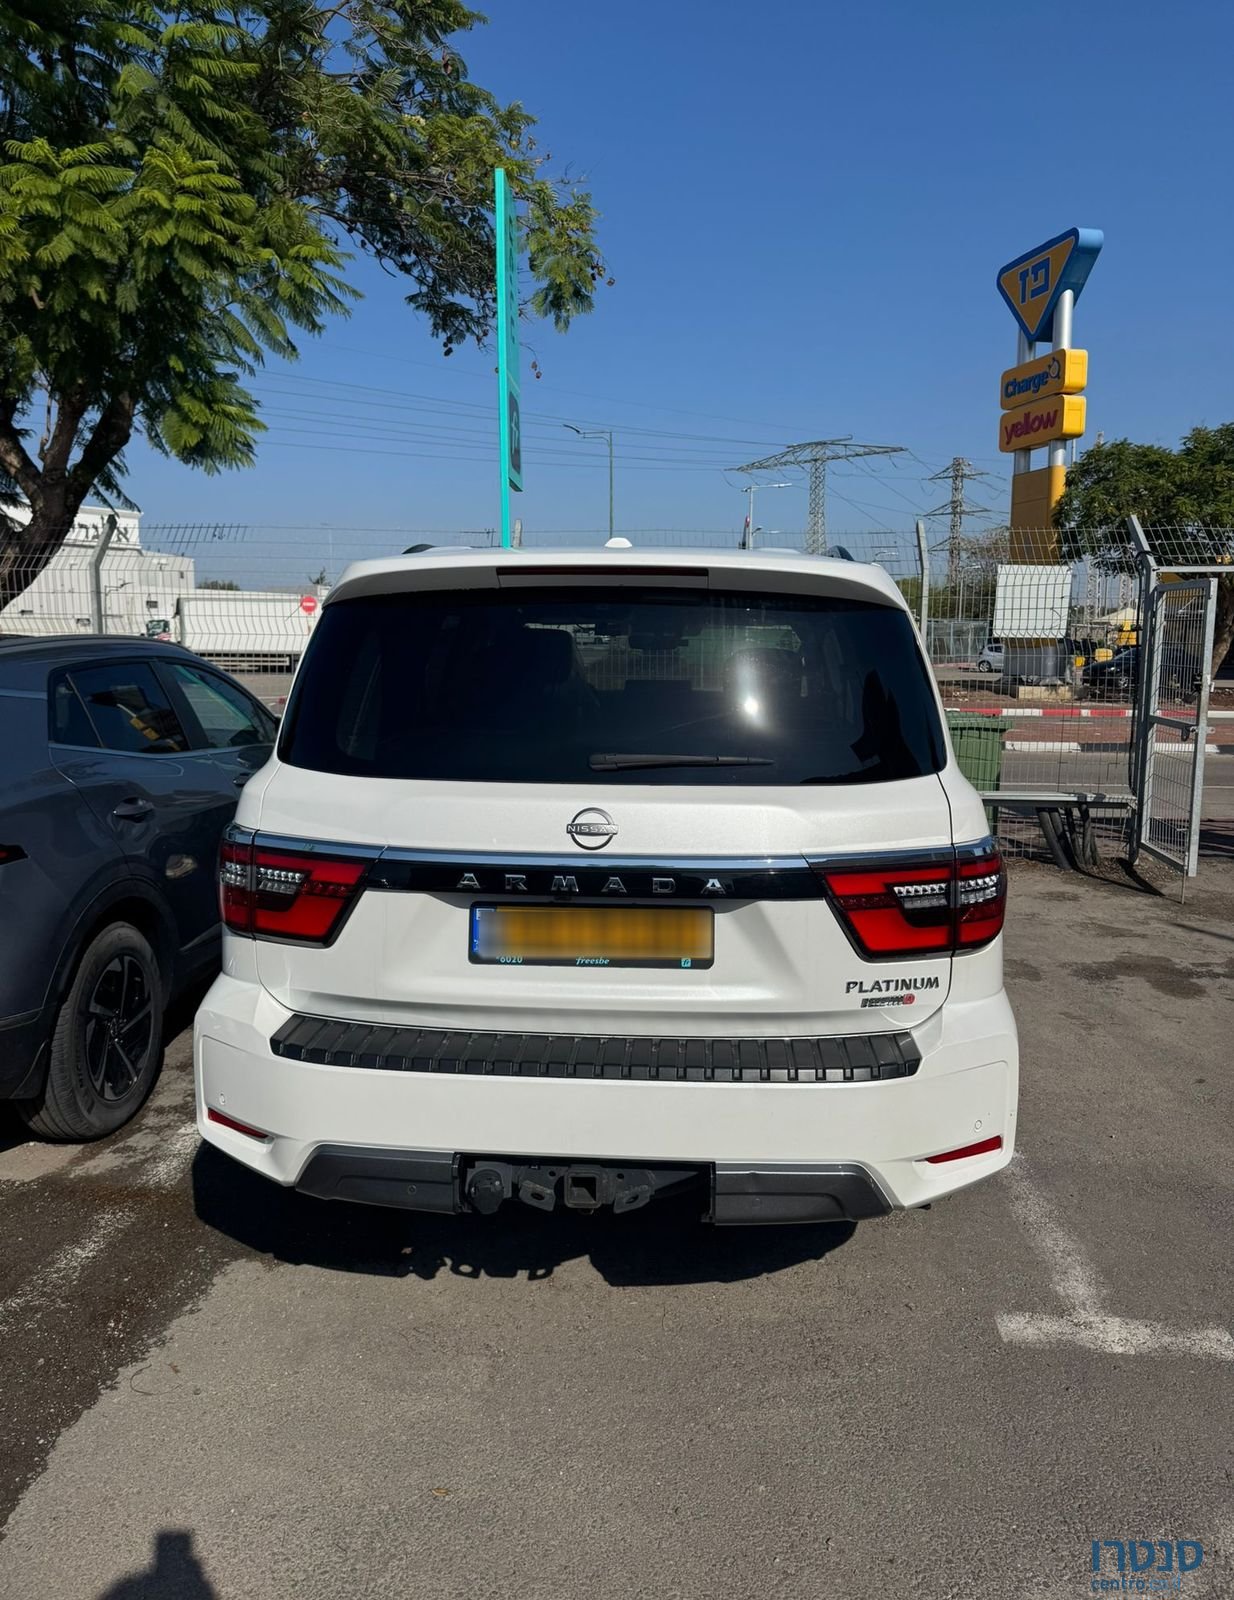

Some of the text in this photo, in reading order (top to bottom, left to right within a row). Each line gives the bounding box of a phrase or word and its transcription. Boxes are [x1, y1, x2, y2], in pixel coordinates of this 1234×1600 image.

[1018, 257, 1050, 304] פז
[1004, 371, 1049, 398] Charge
[1004, 409, 1059, 445] yellow
[567, 824, 617, 834] NISSAN
[456, 872, 727, 895] ARMADA
[575, 956, 610, 966] freesbe
[845, 976, 940, 994] PLATINUM
